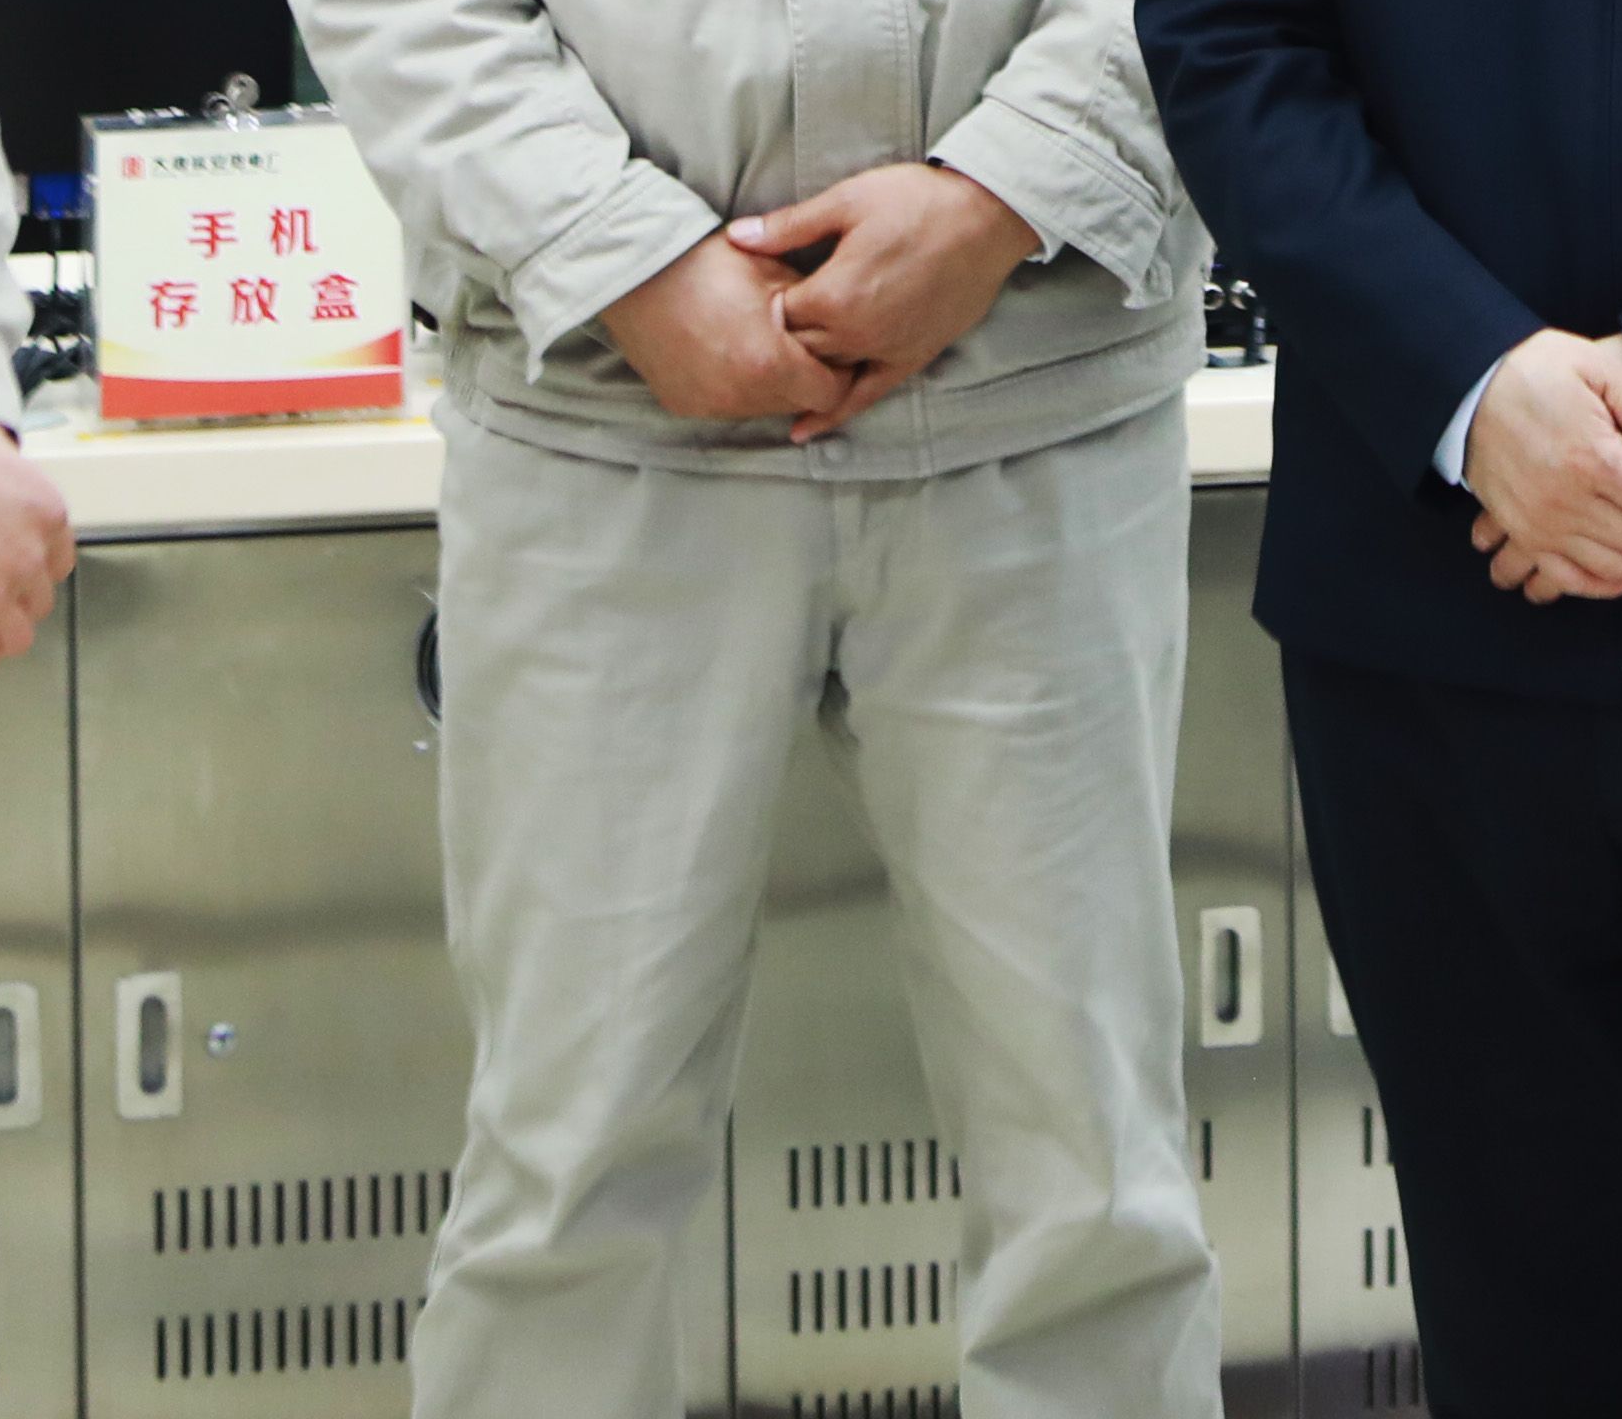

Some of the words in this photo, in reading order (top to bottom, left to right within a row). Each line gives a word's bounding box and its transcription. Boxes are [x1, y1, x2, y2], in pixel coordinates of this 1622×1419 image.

[187, 206, 318, 260] 手机
[150, 273, 358, 330] 存放盒
